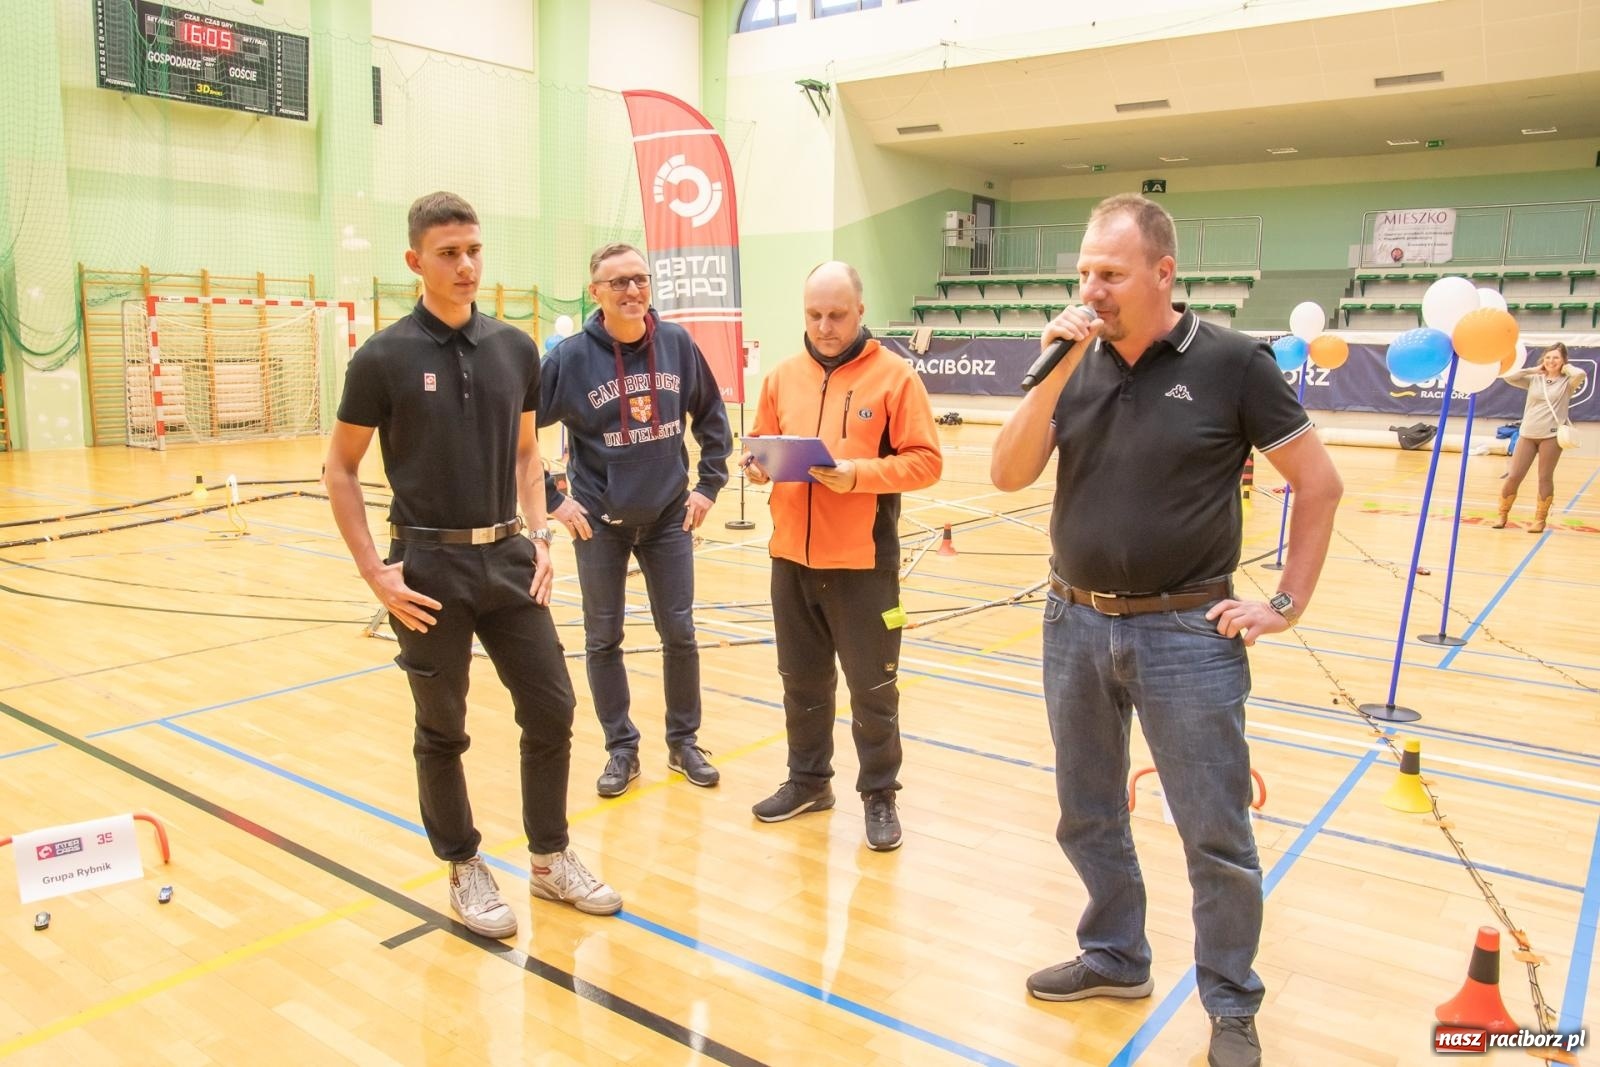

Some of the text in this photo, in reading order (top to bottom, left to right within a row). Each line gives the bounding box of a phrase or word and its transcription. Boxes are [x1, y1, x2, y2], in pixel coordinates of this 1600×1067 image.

[184, 14, 200, 22] CZAS
[204, 18, 220, 26] CZAS
[184, 23, 231, 50] 16:05
[148, 51, 202, 70] GOSPODARZE
[229, 66, 257, 82] GOŚCIE
[1151, 184, 1162, 192] A
[1384, 211, 1447, 224] MIESZKO
[42, 862, 112, 886] Grupa Rybnik
